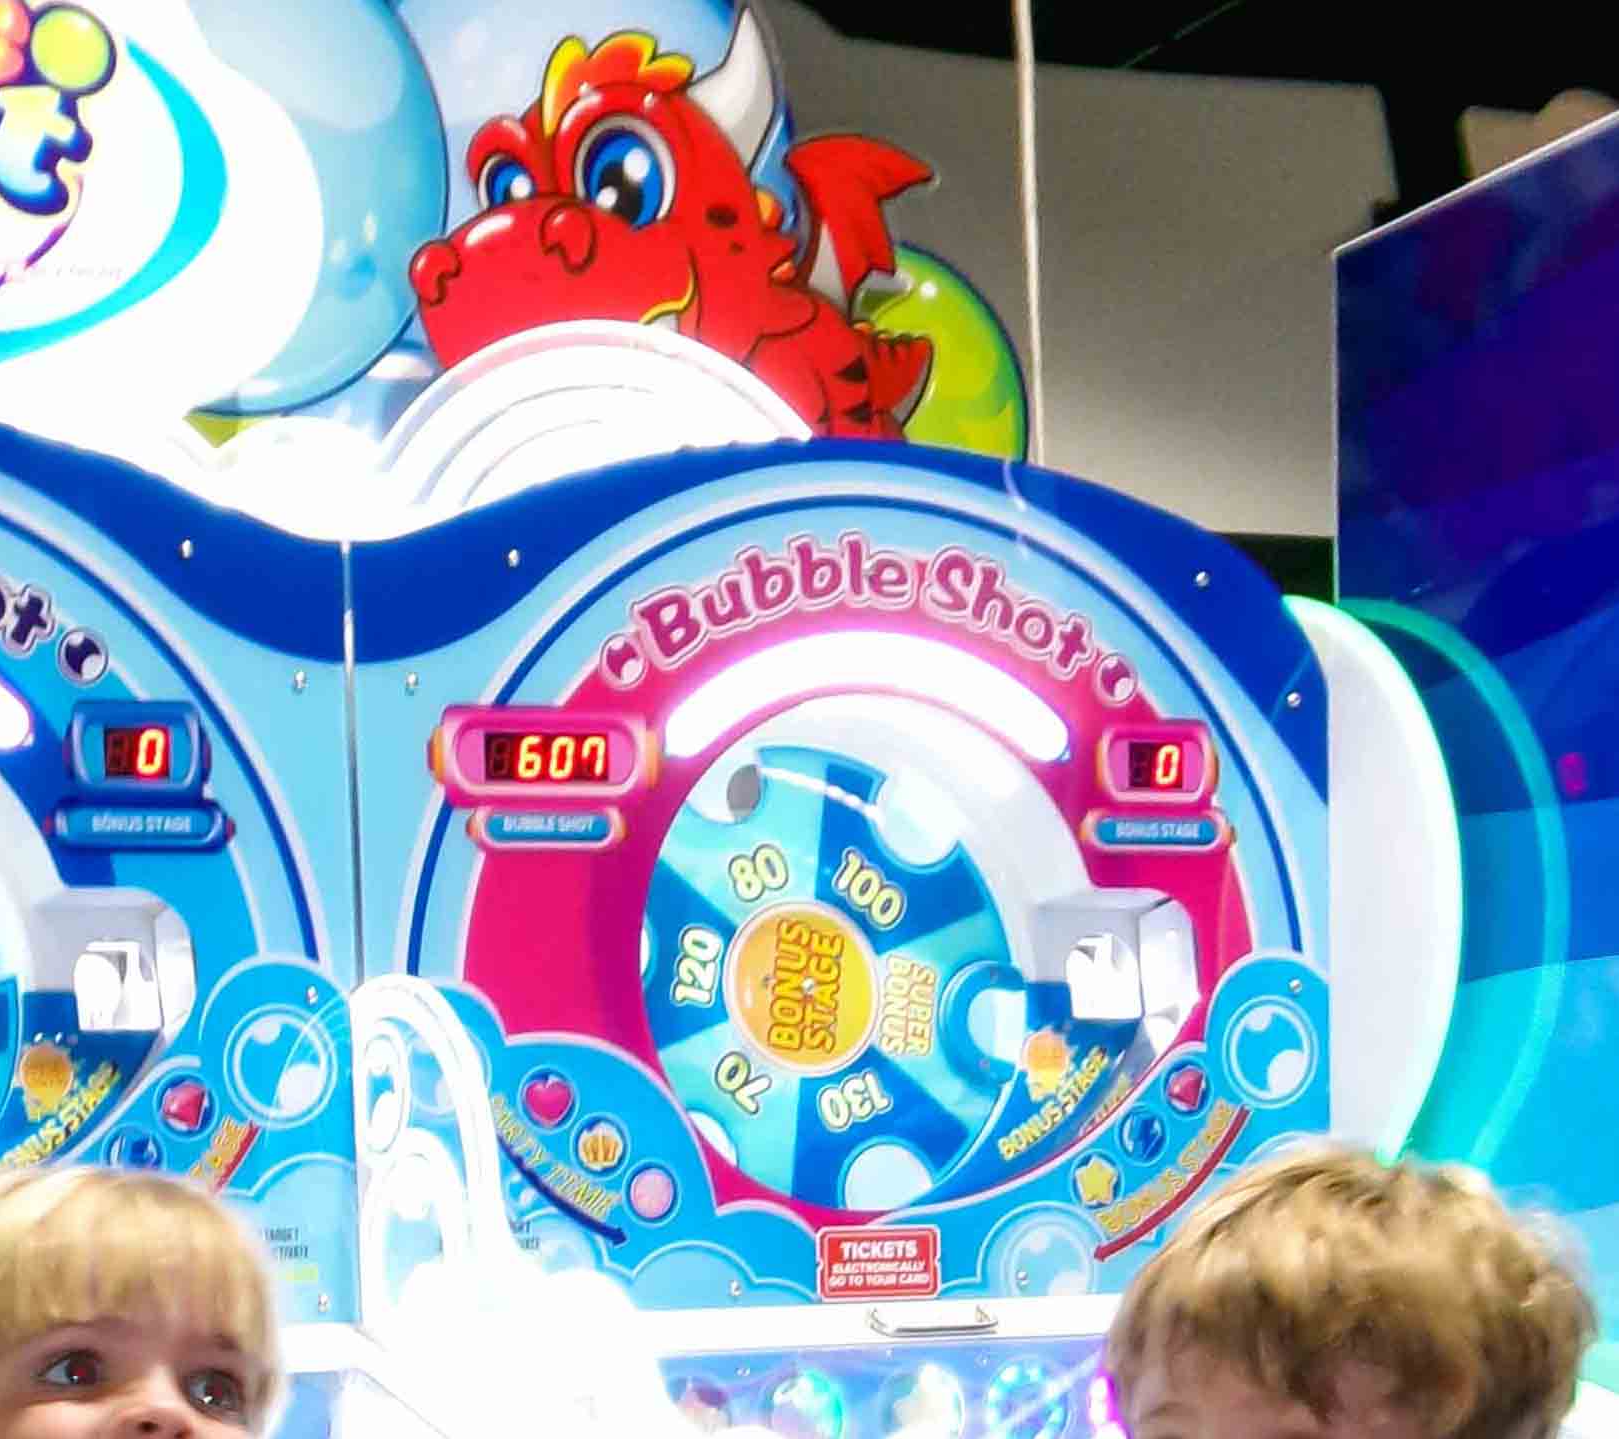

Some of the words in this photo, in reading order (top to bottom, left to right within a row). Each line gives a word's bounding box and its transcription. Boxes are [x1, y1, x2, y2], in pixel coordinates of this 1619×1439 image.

[632, 532, 912, 666] Bubble
[924, 546, 1091, 674] Shot
[136, 727, 166, 775] 0
[517, 735, 607, 780] 607
[1155, 744, 1180, 785] 0
[727, 844, 789, 902] 80
[832, 847, 907, 931] 100
[669, 924, 724, 1008] 120
[767, 917, 811, 1052] BONUS
[800, 927, 845, 1054] STAGE
[880, 953, 912, 1056] BONUS
[904, 962, 937, 1057] SUPER
[713, 1050, 773, 1115] 70
[816, 1070, 895, 1134] 130
[997, 1098, 1066, 1162] BONUS
[828, 1275, 847, 1288] GO
[848, 1274, 864, 1287] TO
[839, 1240, 918, 1261] TICKETS
